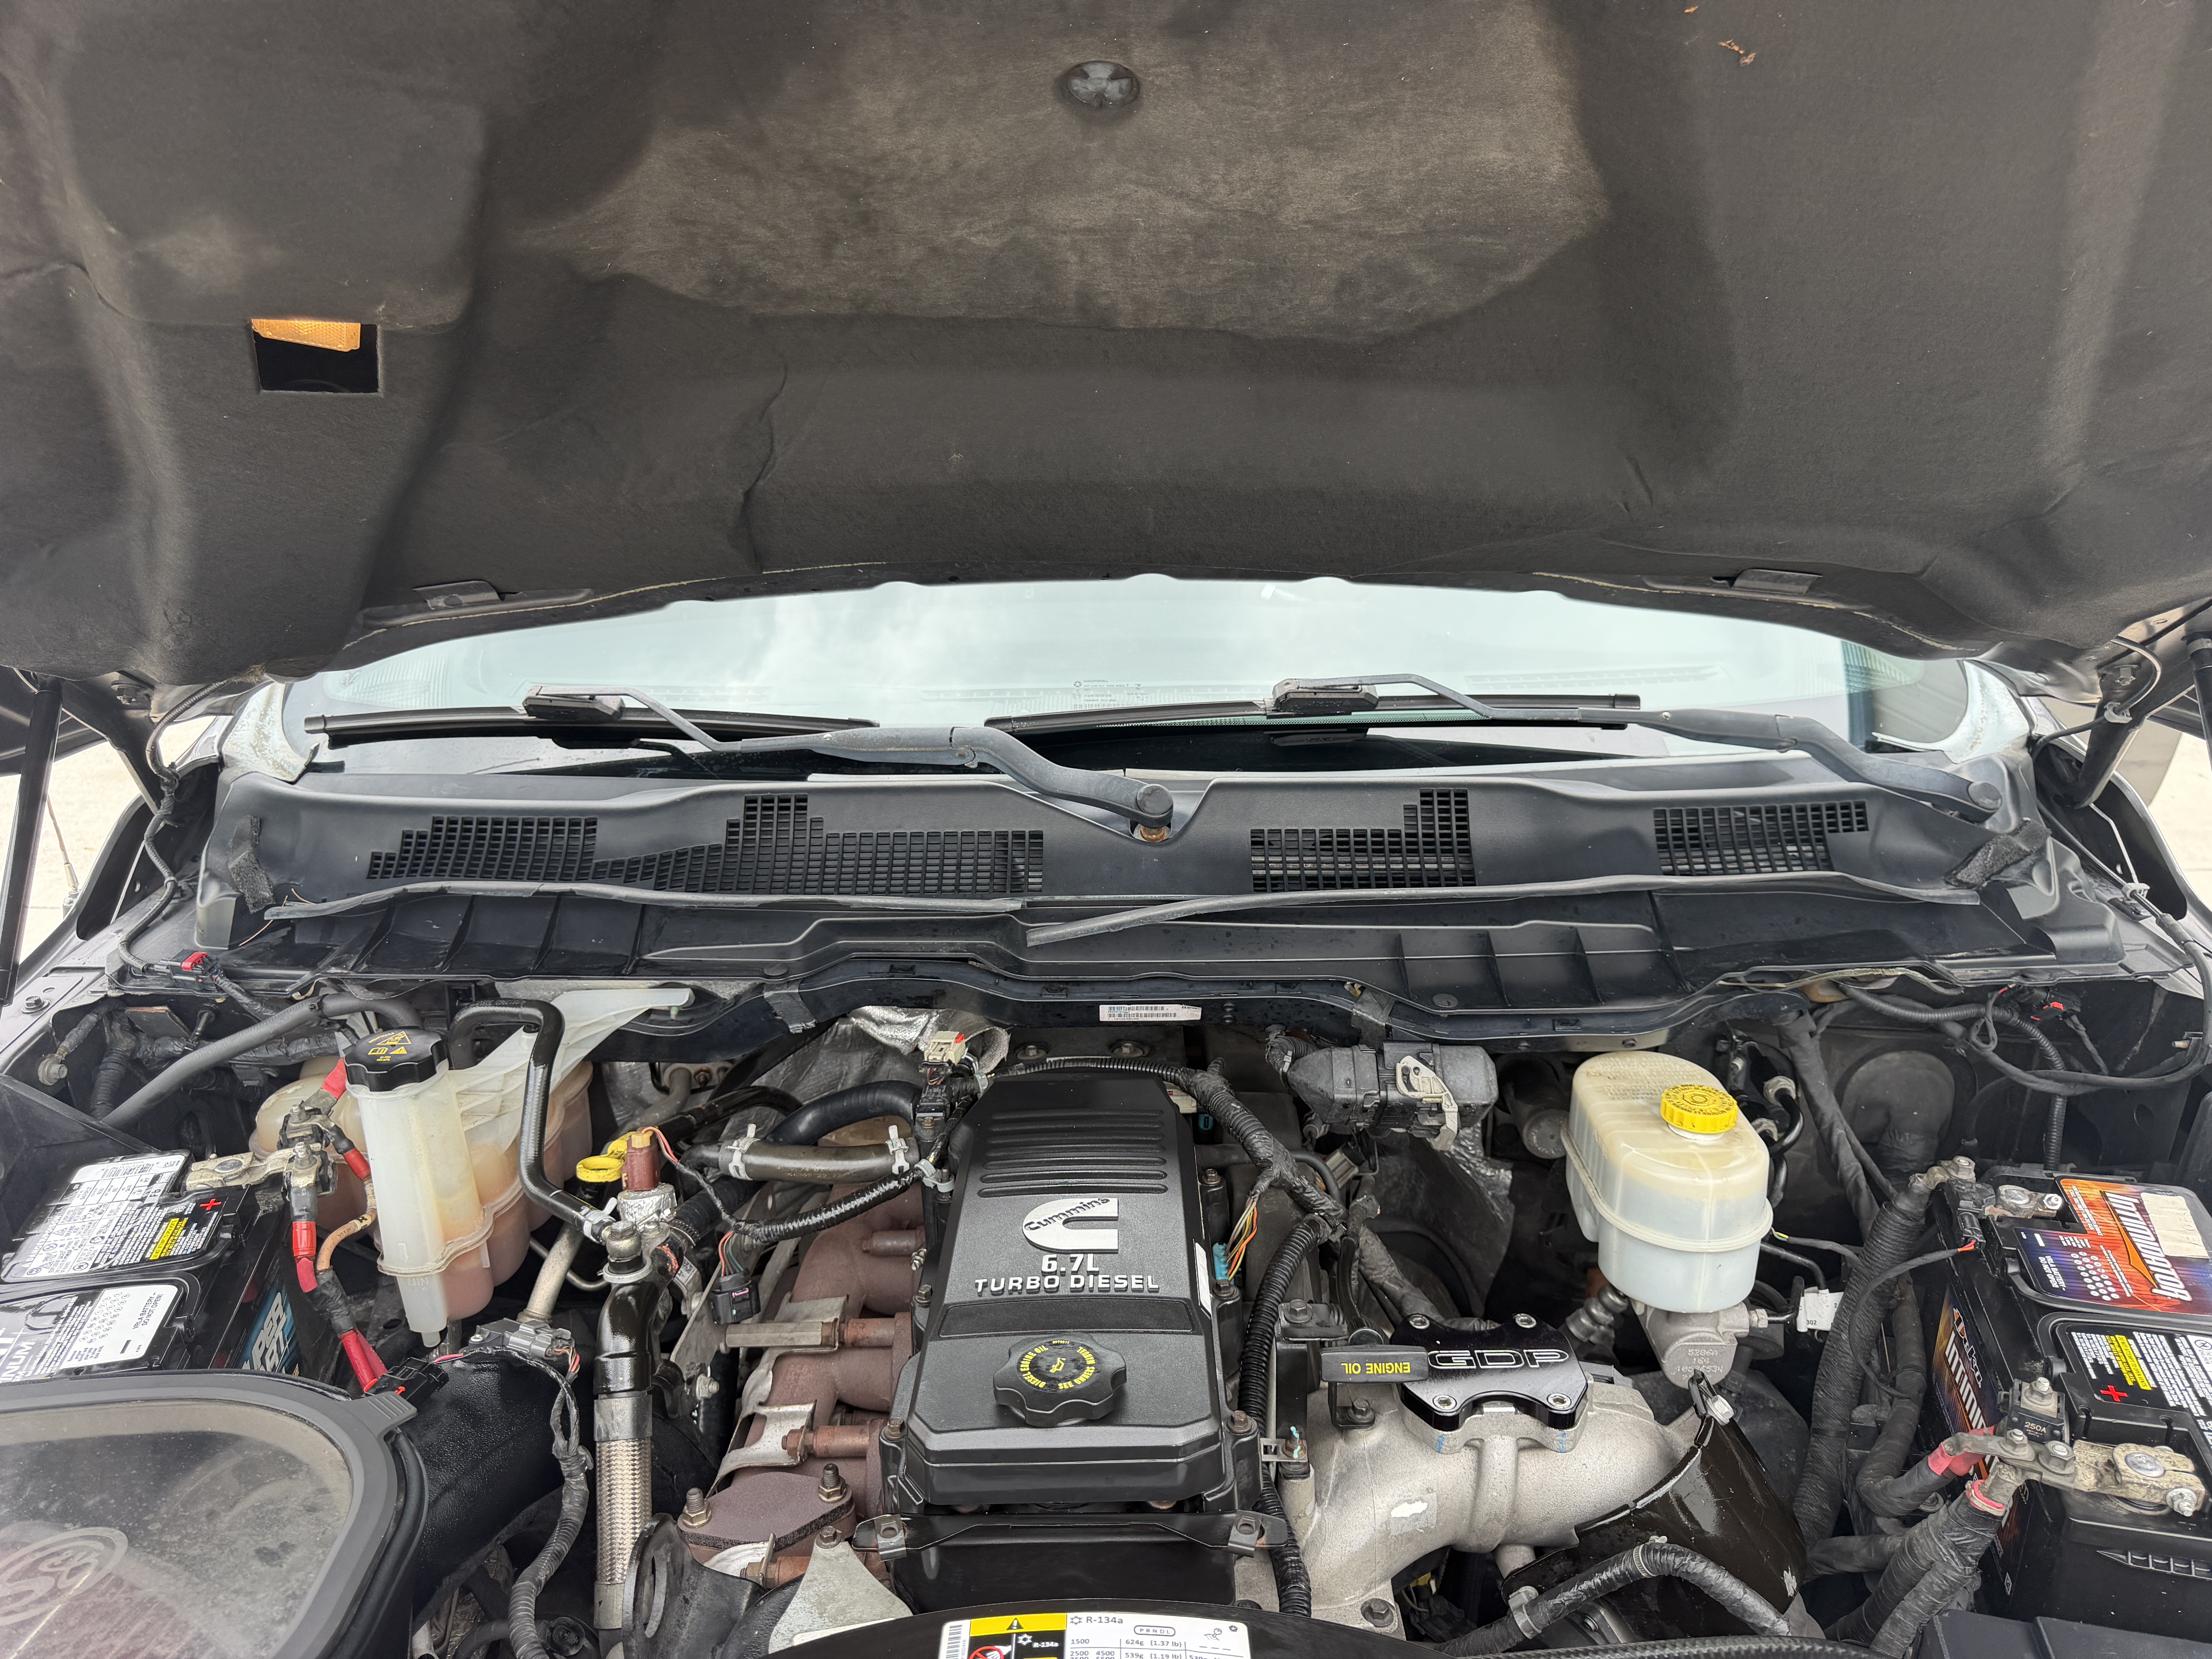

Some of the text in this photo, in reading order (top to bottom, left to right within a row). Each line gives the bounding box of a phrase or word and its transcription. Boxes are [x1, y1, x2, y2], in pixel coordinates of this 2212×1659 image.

[1041, 1254, 1099, 1276] 6.7L
[2041, 1264, 2052, 1273] NOT
[2045, 1255, 2056, 1267] VRLA
[2051, 1267, 2066, 1287] BATTERY
[975, 1274, 1159, 1295] TURBO DIESEL
[2046, 1273, 2059, 1288] OPEN!
[131, 1316, 144, 1329] VRLA
[139, 1296, 156, 1316] BATTERY
[144, 1309, 155, 1318] NOT
[150, 1294, 163, 1308] OPEN!
[252, 1292, 283, 1370] PER
[1428, 1349, 1569, 1369] GDP
[2123, 1348, 2135, 1362] ATTEMPT
[1020, 1345, 1049, 1388] DIESEL ENGINE OIL
[1058, 1346, 1096, 1389] SEE OWNERS MANUAL
[1341, 1362, 1411, 1374] ENGINE OIL
[2133, 1367, 2142, 1376] OPEN
[2137, 1376, 2148, 1387] VENTS.
[2025, 1422, 2046, 1433] 250A
